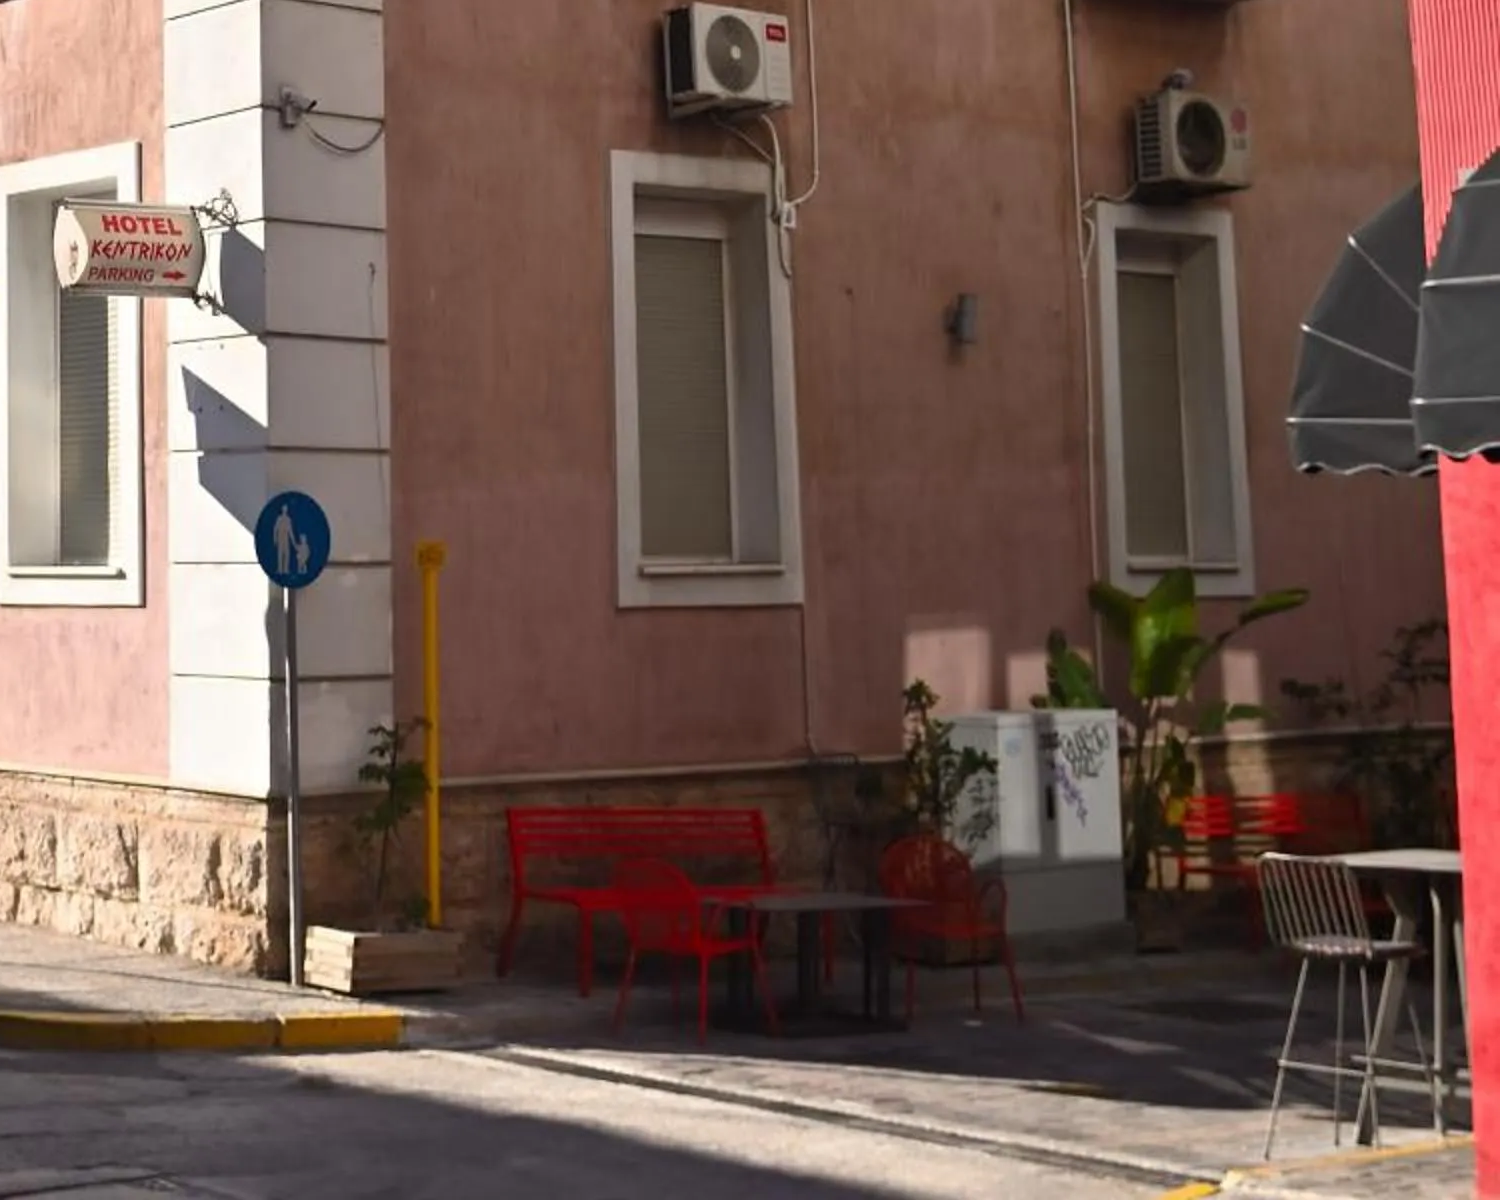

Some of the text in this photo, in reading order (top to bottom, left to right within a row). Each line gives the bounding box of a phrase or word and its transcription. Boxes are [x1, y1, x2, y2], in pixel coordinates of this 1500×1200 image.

[102, 215, 182, 236] HOTEL
[91, 239, 193, 261] KENTRIKON
[88, 266, 155, 282] PARKING
